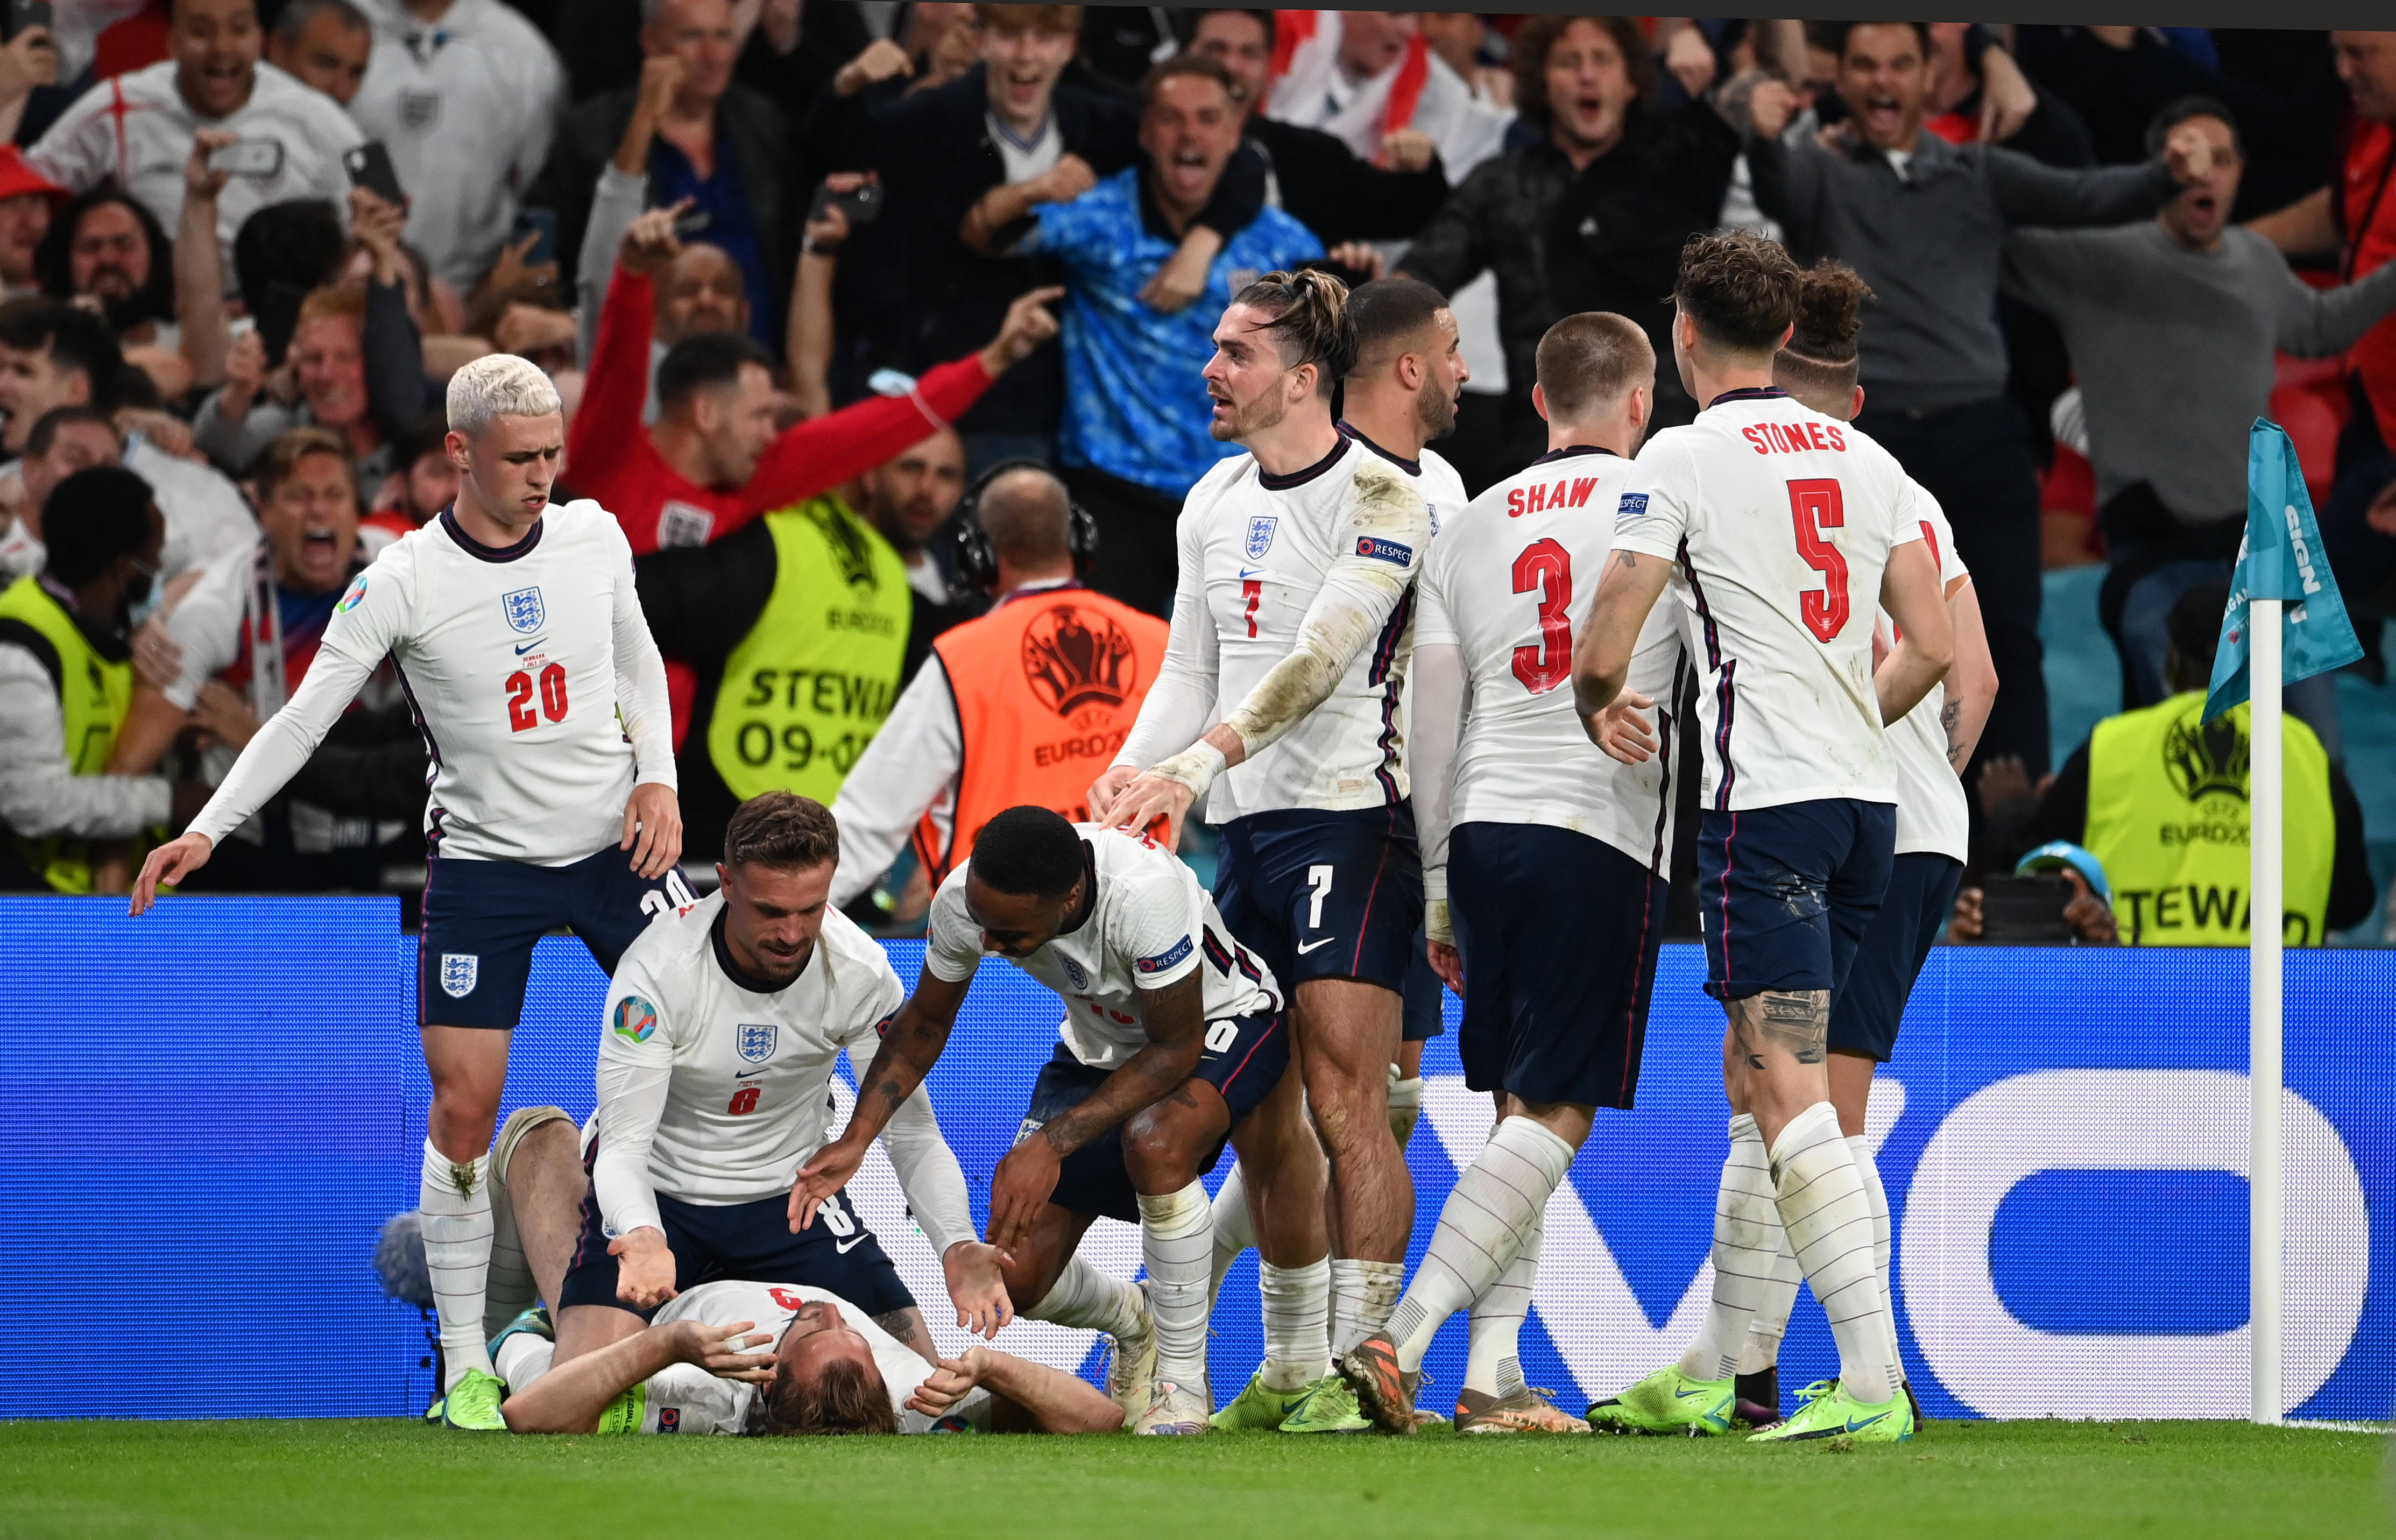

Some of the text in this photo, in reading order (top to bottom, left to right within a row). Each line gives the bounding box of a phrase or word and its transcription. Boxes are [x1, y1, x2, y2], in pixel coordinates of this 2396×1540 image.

[1742, 422, 1846, 455] STONES
[1508, 478, 1598, 518] SHAW
[1621, 499, 1646, 508] ESPECT
[1375, 545, 1411, 562] RESPECT
[1786, 478, 1849, 644] 5
[1241, 580, 1262, 638] 7
[1512, 538, 1572, 695] 3
[523, 653, 545, 662] DENMARK
[505, 663, 568, 733] 20
[1308, 865, 1333, 928] 7
[1156, 939, 1191, 967] RESPECT
[1204, 1019, 1239, 1053] 0
[727, 1087, 761, 1115] 8
[817, 1194, 855, 1237] 8
